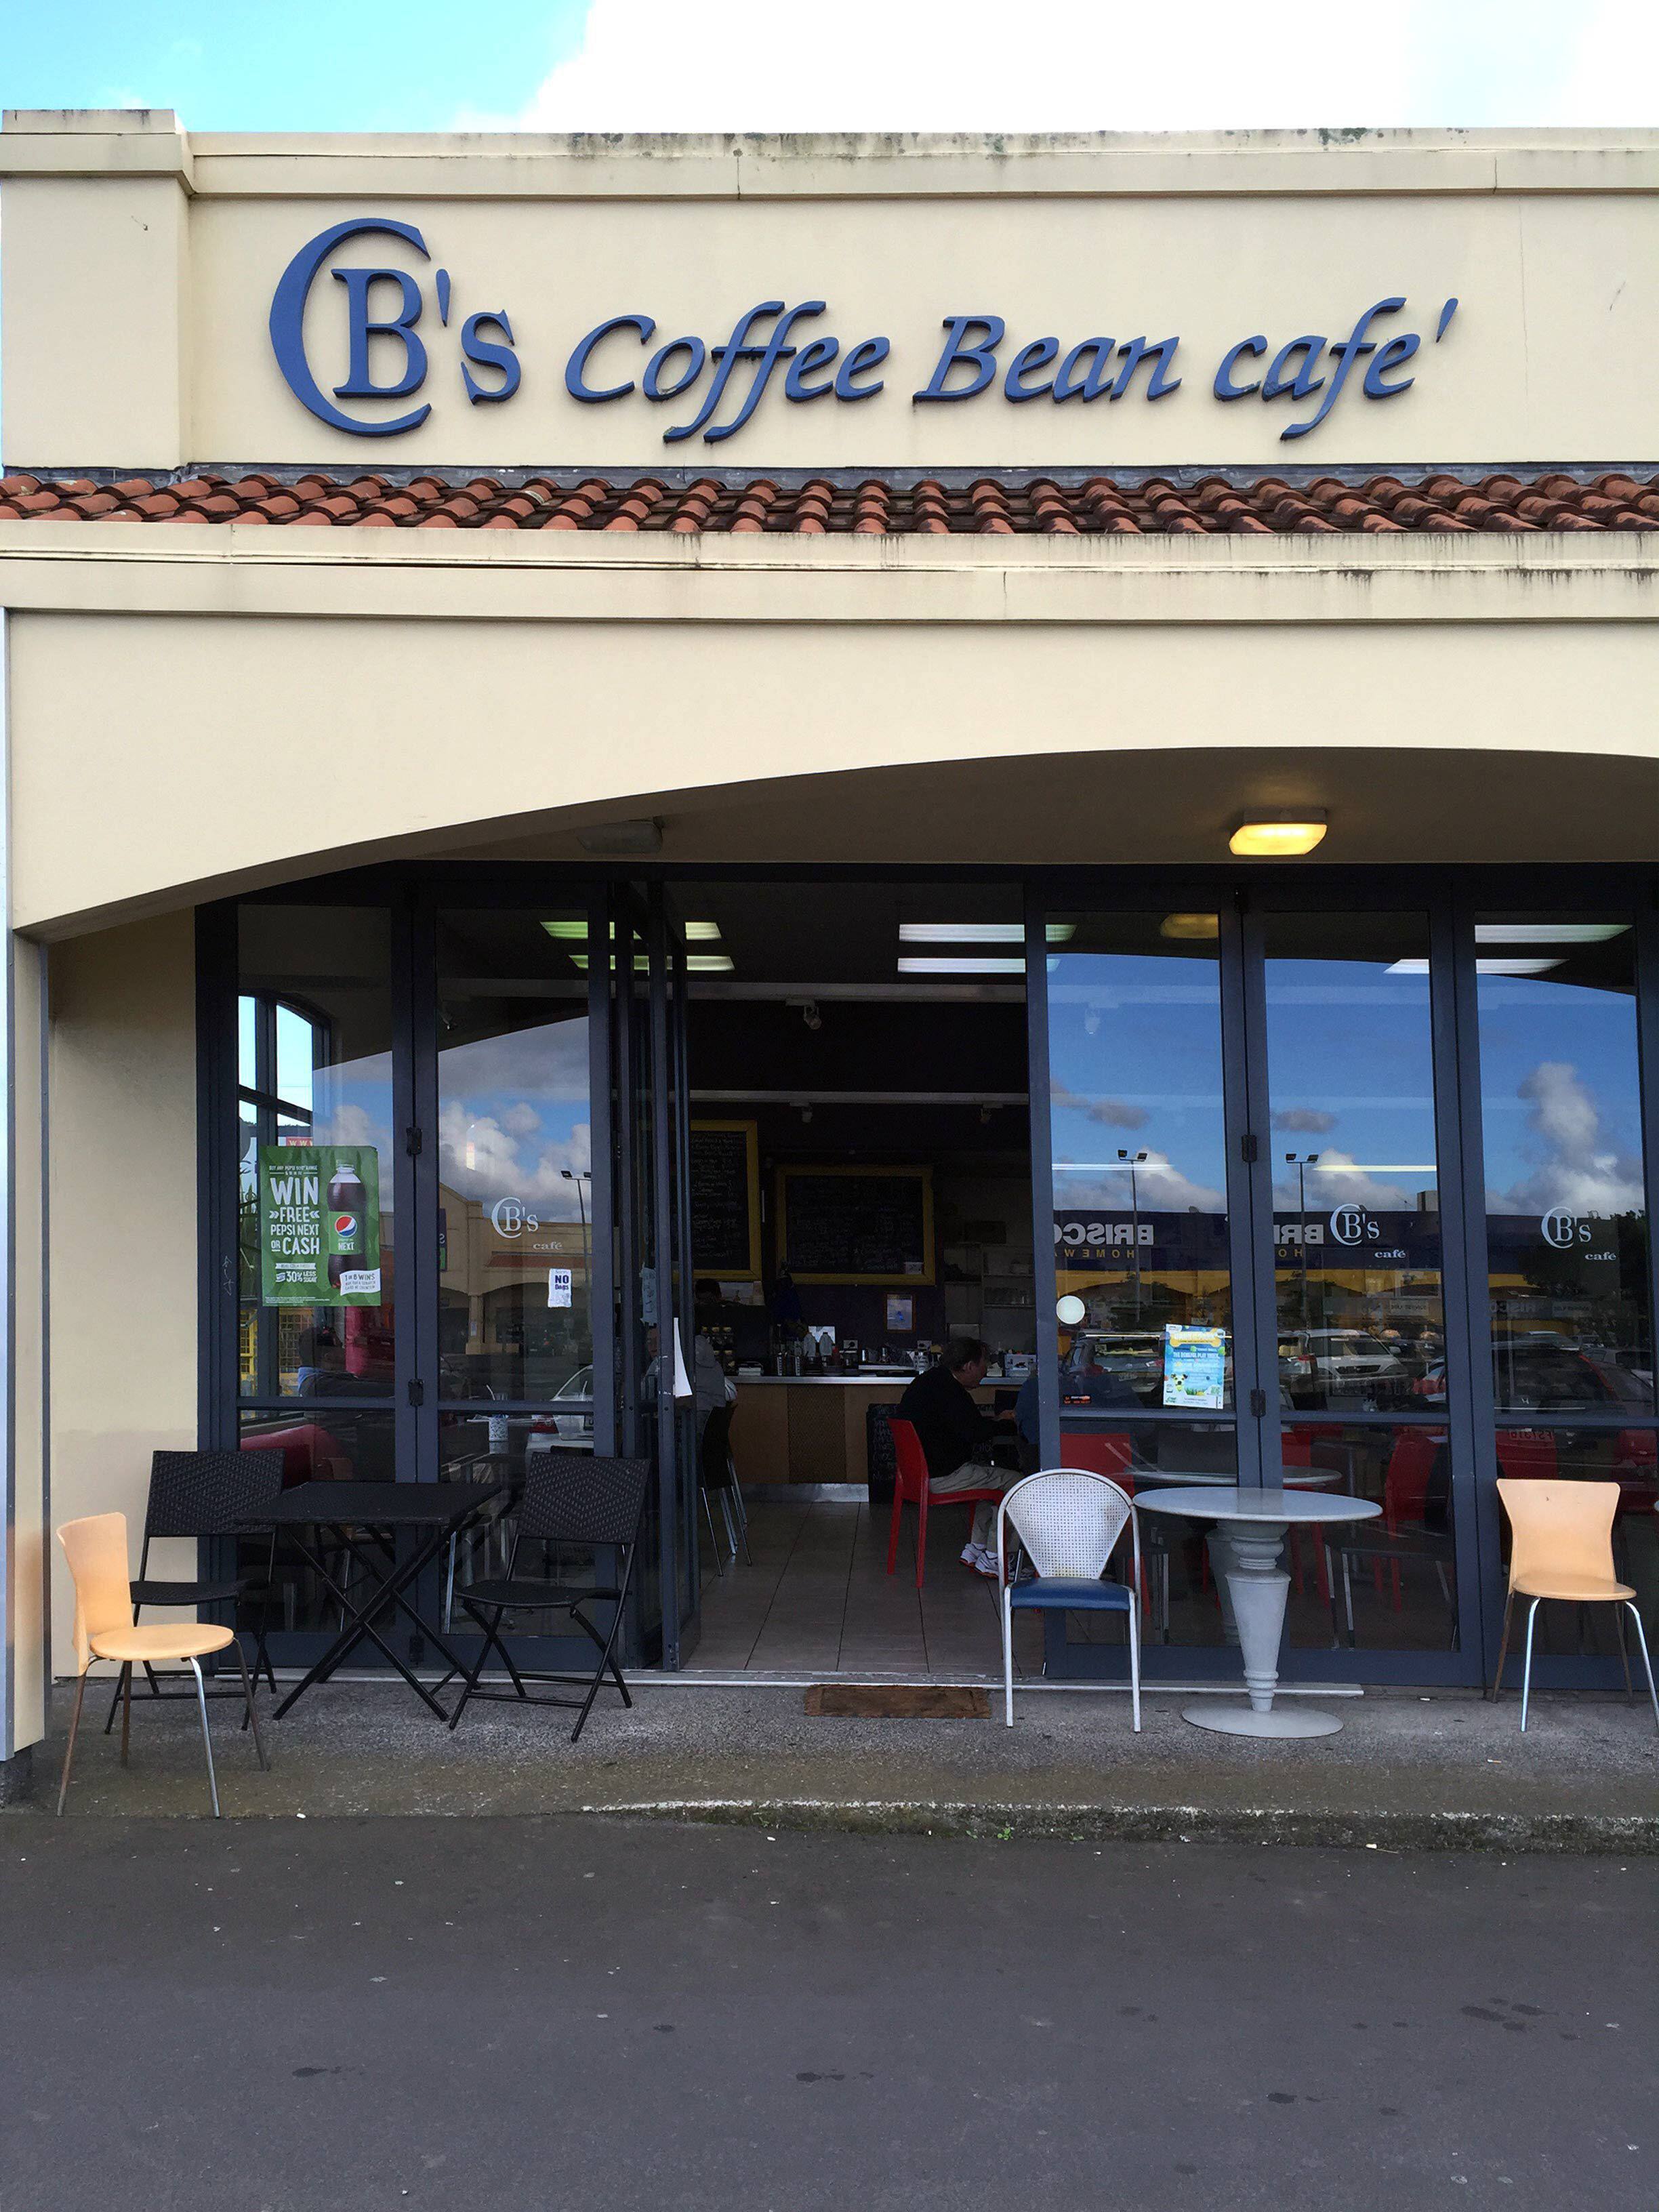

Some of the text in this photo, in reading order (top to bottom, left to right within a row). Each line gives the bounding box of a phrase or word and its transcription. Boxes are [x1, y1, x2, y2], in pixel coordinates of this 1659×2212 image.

[269, 218, 522, 437] CB's
[564, 300, 890, 444] Coffee
[912, 315, 1182, 407] Bean
[270, 1176, 319, 1205] WIN
[280, 1206, 310, 1223] FREE
[491, 1197, 539, 1239] CB's
[270, 1224, 319, 1235] PEPSI NEXT
[1330, 1204, 1380, 1246] CB's
[1540, 1206, 1592, 1249] CB's
[271, 1237, 320, 1255] OR CASH
[338, 1242, 354, 1251] NEXT
[533, 1242, 564, 1250] café
[1374, 1249, 1406, 1258] café
[1584, 1252, 1617, 1261] café
[286, 1271, 303, 1283] 30%
[555, 1275, 569, 1284] NO
